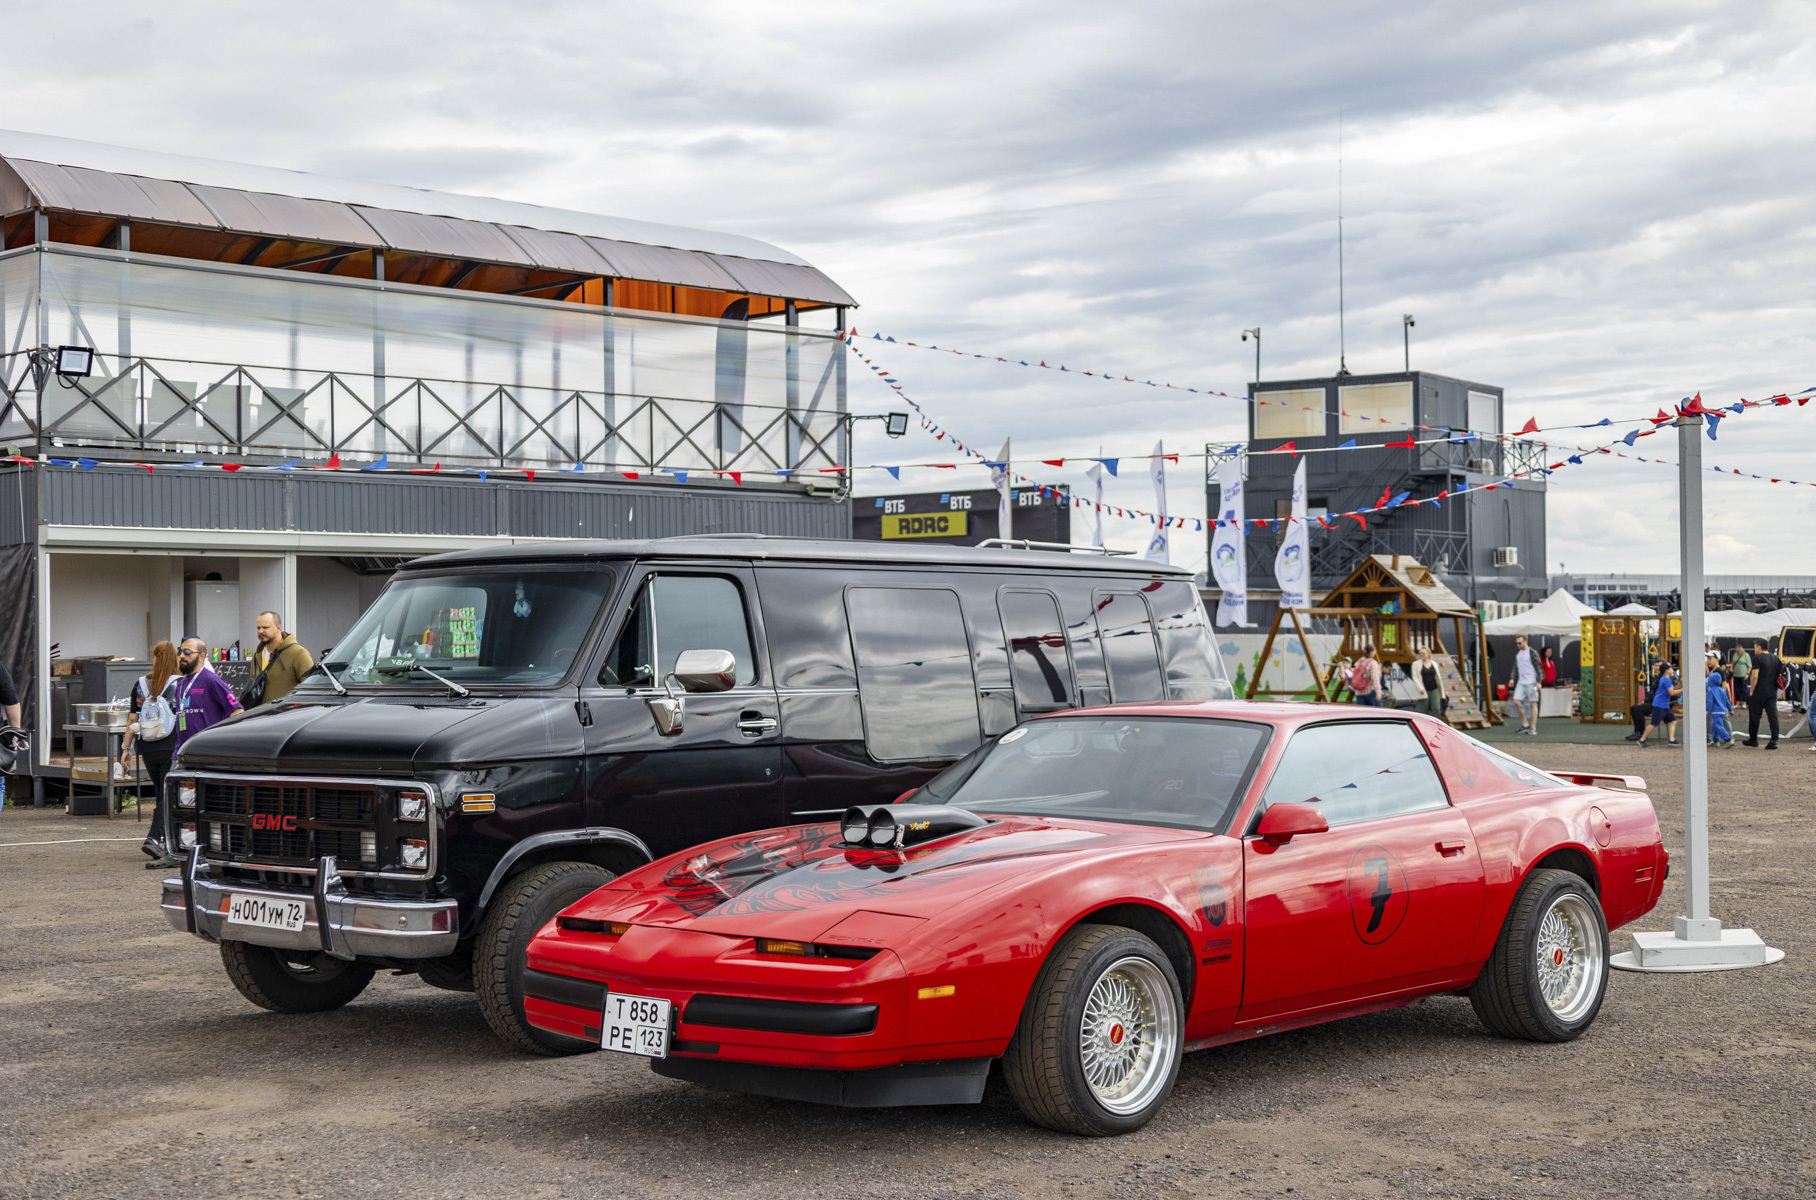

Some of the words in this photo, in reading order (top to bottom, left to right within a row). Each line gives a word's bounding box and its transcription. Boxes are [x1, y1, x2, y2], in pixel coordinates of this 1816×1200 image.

[884, 499, 906, 514] ВТБ
[950, 495, 973, 510] ВТБ
[1019, 491, 1042, 507] ВТБ
[898, 516, 950, 535] RDRC
[252, 814, 297, 830] GMC
[629, 1000, 659, 1024] 858
[640, 1029, 663, 1048] 123
